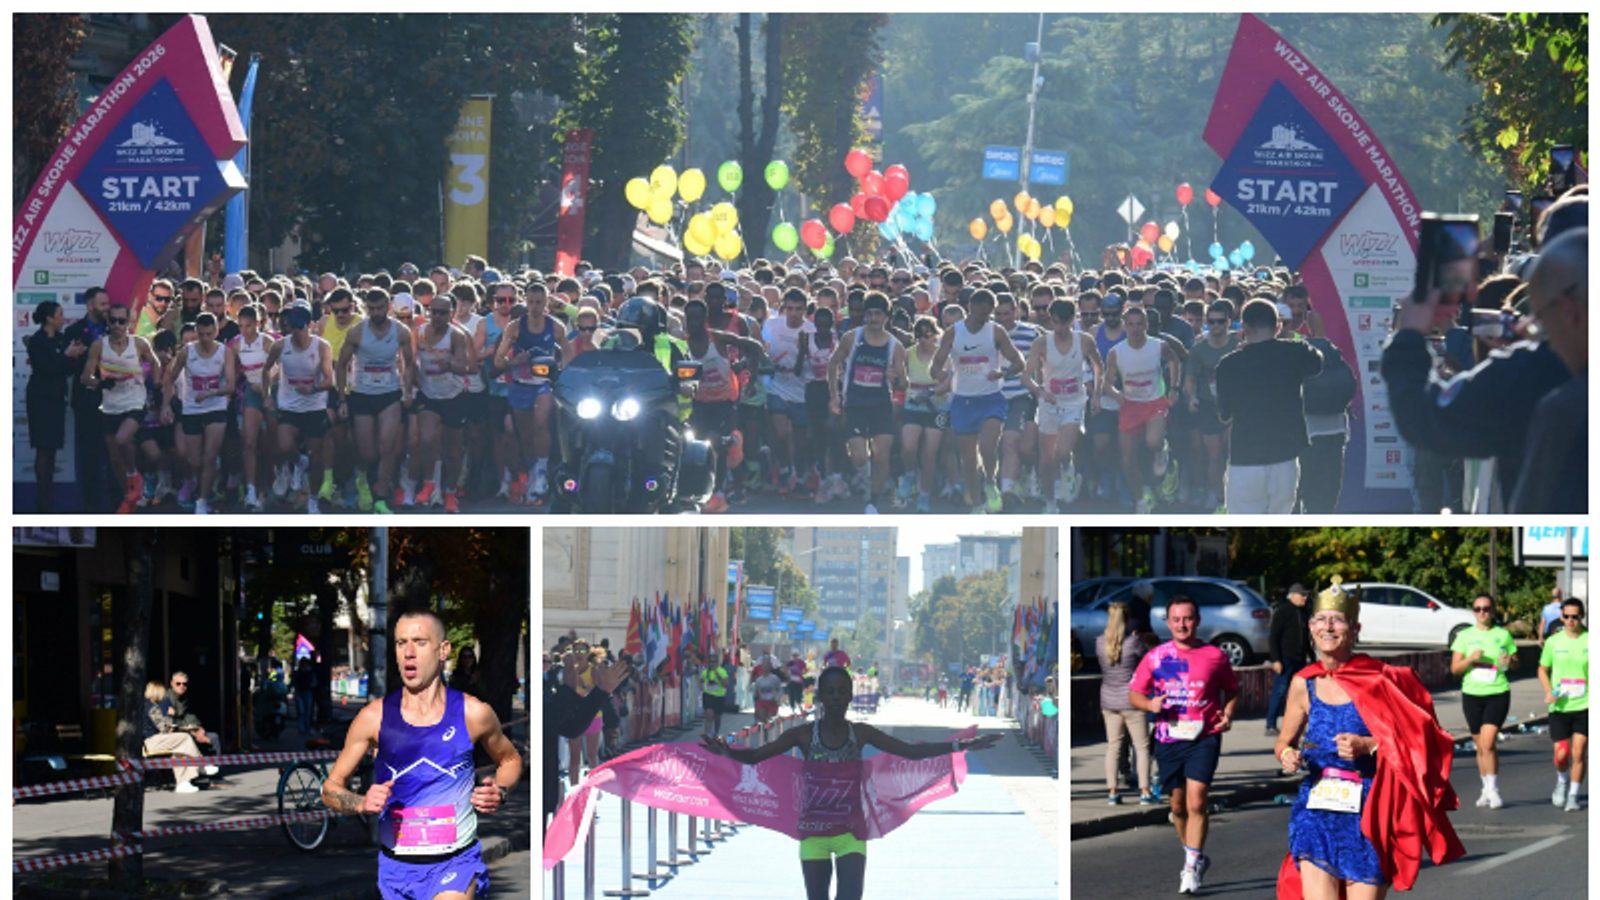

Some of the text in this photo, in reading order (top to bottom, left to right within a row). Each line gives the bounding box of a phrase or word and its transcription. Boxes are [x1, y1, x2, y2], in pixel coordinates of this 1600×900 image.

[1274, 40, 1309, 76] WIZZ
[1306, 74, 1331, 98] AIR
[1327, 96, 1371, 147] SKOPJE
[1365, 147, 1421, 227] MARATHON
[13, 44, 166, 262] IZZ AIR SKOPJE MARATHON 2026
[102, 176, 200, 199] START
[448, 154, 486, 205] 3
[1237, 179, 1339, 203] START
[108, 201, 141, 212] 21km
[154, 201, 191, 211] 42km
[561, 173, 584, 216] 4
[1247, 203, 1281, 215] 21km
[1294, 205, 1331, 216] 42km
[301, 543, 333, 555] CLUB
